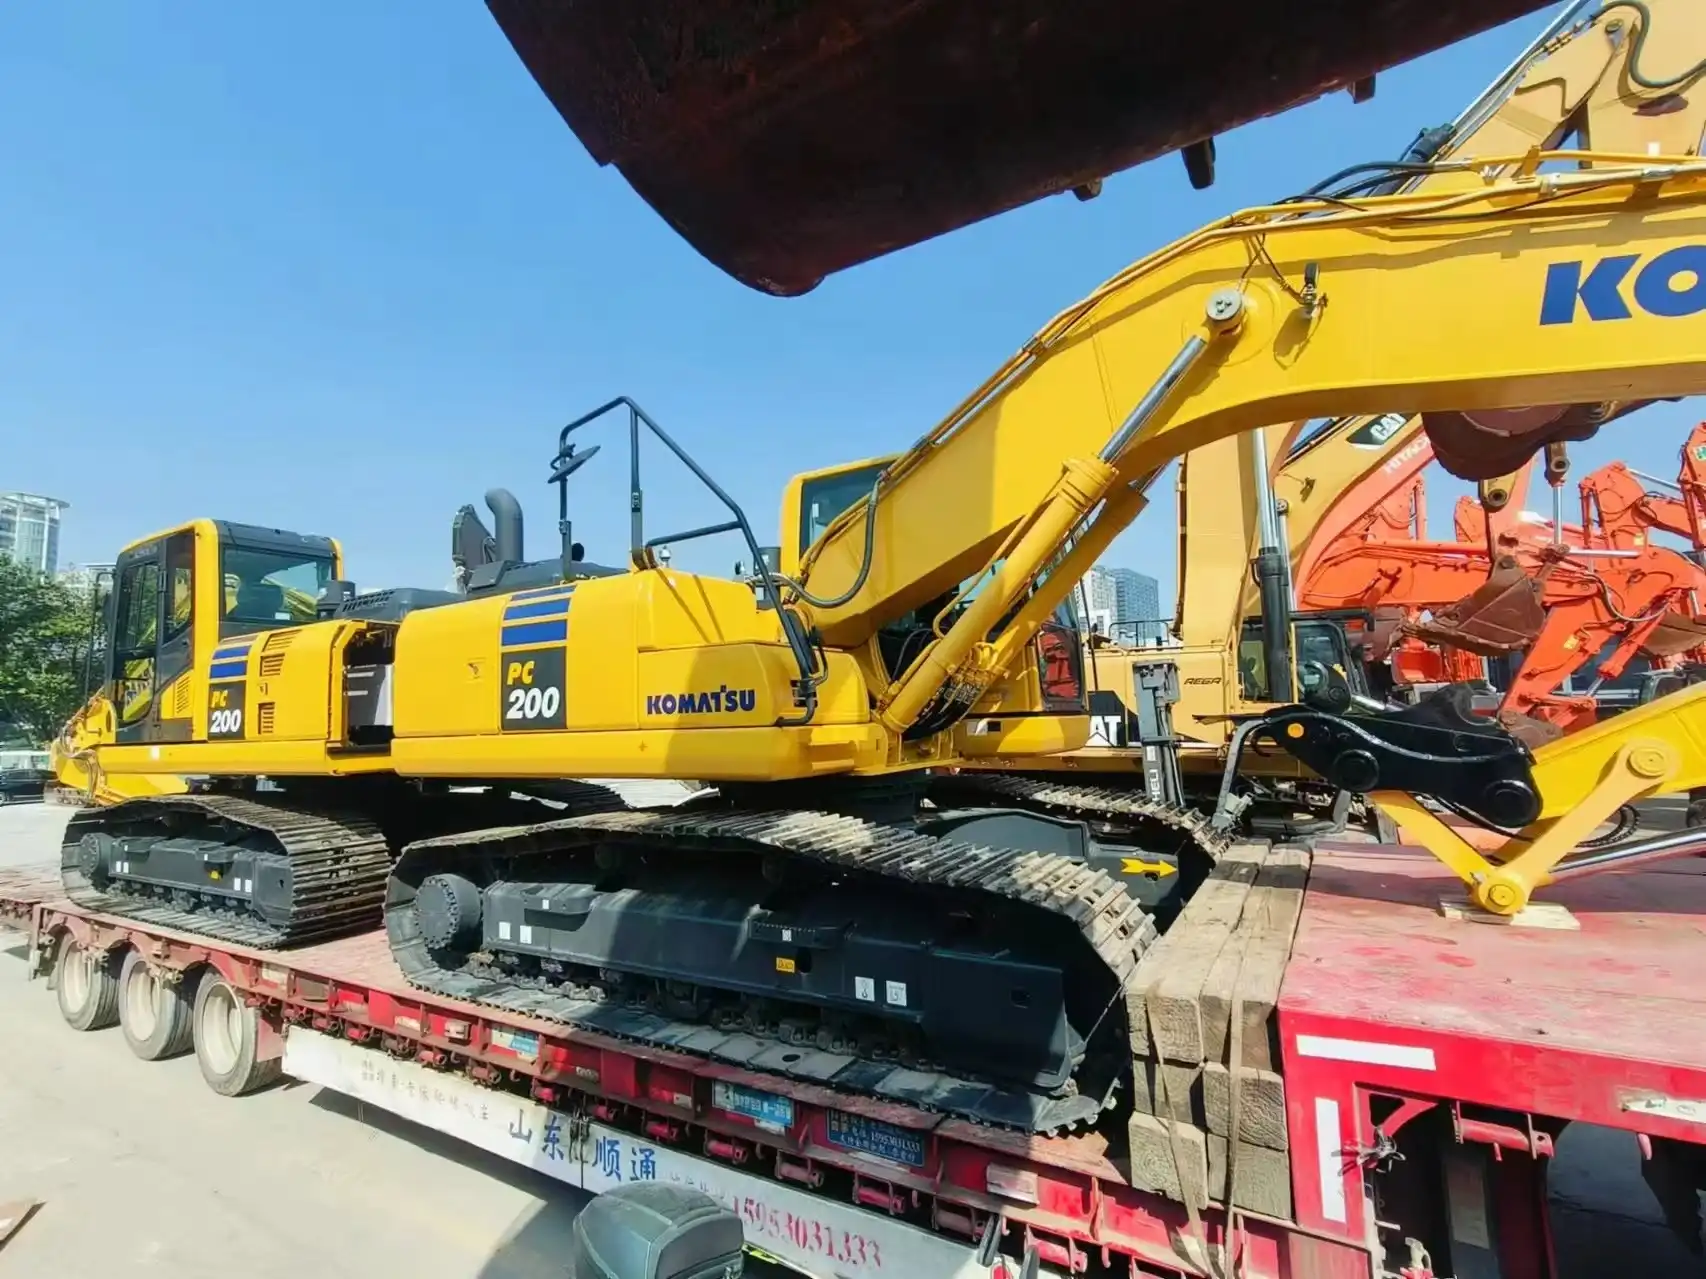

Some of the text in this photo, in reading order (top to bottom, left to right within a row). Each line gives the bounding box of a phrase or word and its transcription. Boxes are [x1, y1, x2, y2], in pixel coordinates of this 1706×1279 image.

[1540, 244, 1706, 326] KO
[1369, 413, 1407, 441] CAT
[507, 661, 535, 685] PC
[211, 690, 228, 708] PC
[506, 687, 560, 719] 200
[647, 685, 756, 716] KOMATSU
[209, 709, 242, 733] 200
[1149, 768, 1160, 801] HELI
[509, 1109, 656, 1182] 山东顺通
[732, 1195, 882, 1268] 15953031333
